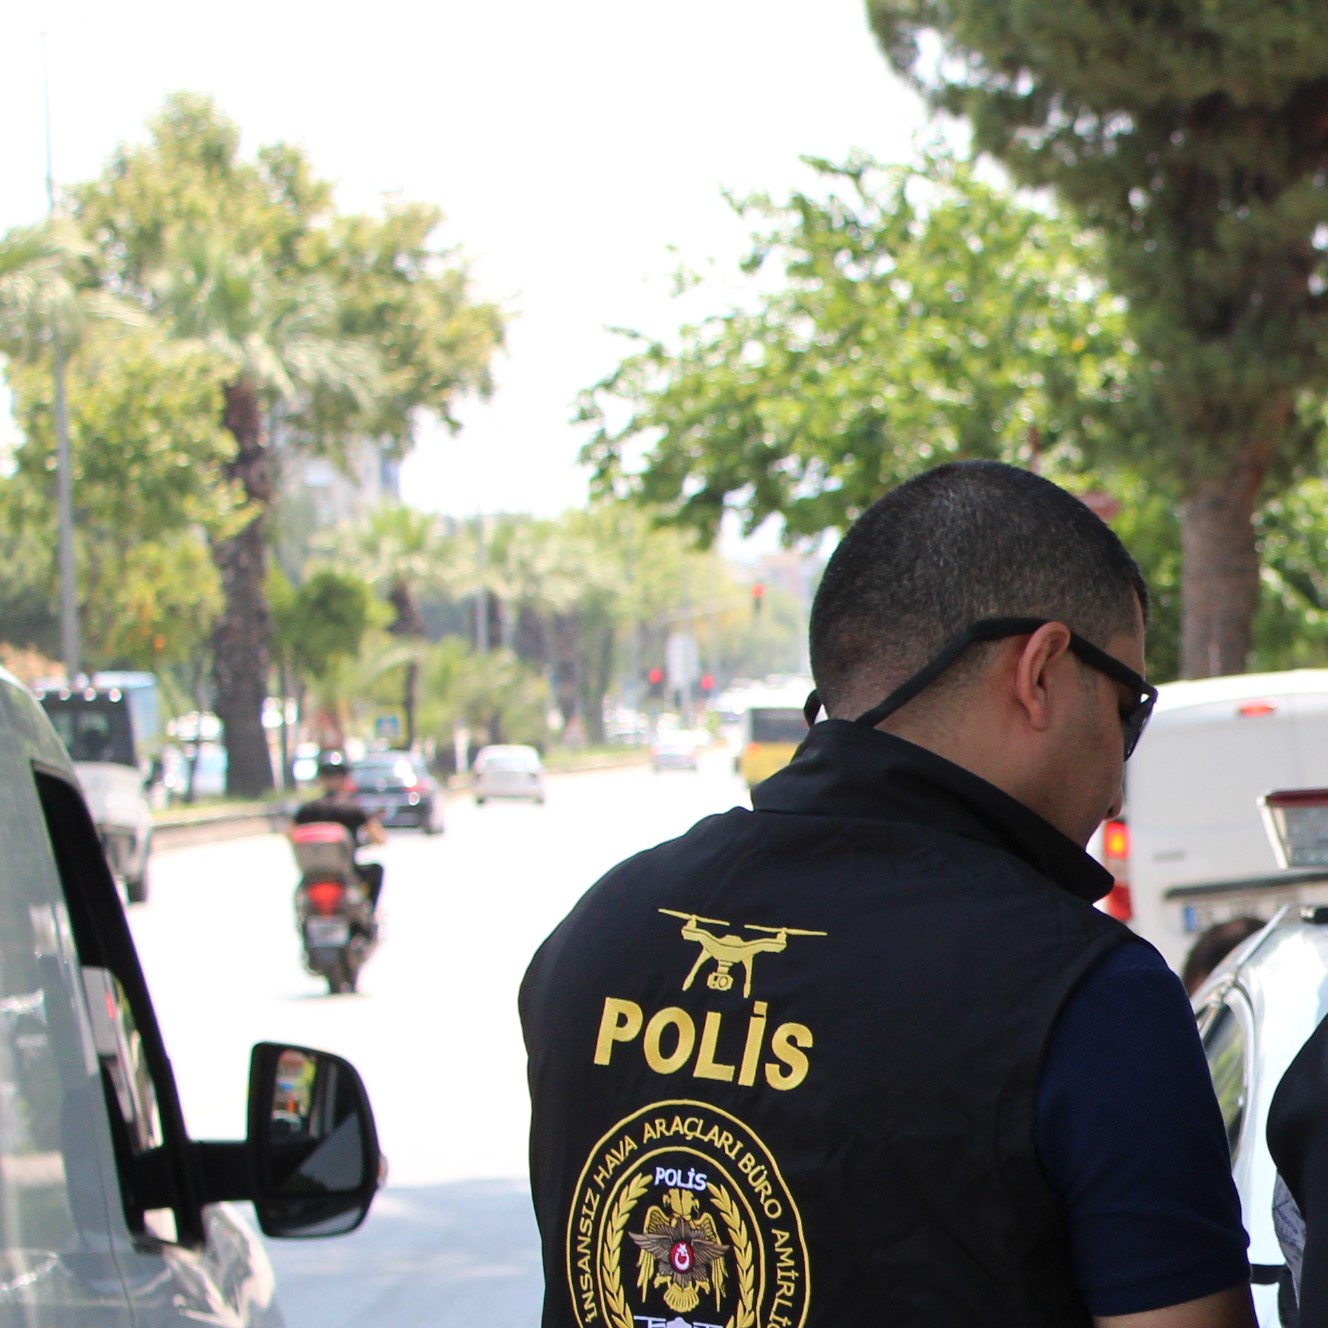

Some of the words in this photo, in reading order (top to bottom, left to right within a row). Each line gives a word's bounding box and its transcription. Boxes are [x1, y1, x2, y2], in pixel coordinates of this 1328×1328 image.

[593, 997, 814, 1092] POLİS
[575, 1187, 601, 1324] İNSANSIZ
[593, 1136, 638, 1191] HAVA
[642, 1115, 741, 1162] ARAÇLARI
[737, 1150, 783, 1220] BÜRO
[654, 1166, 708, 1192] POLİS
